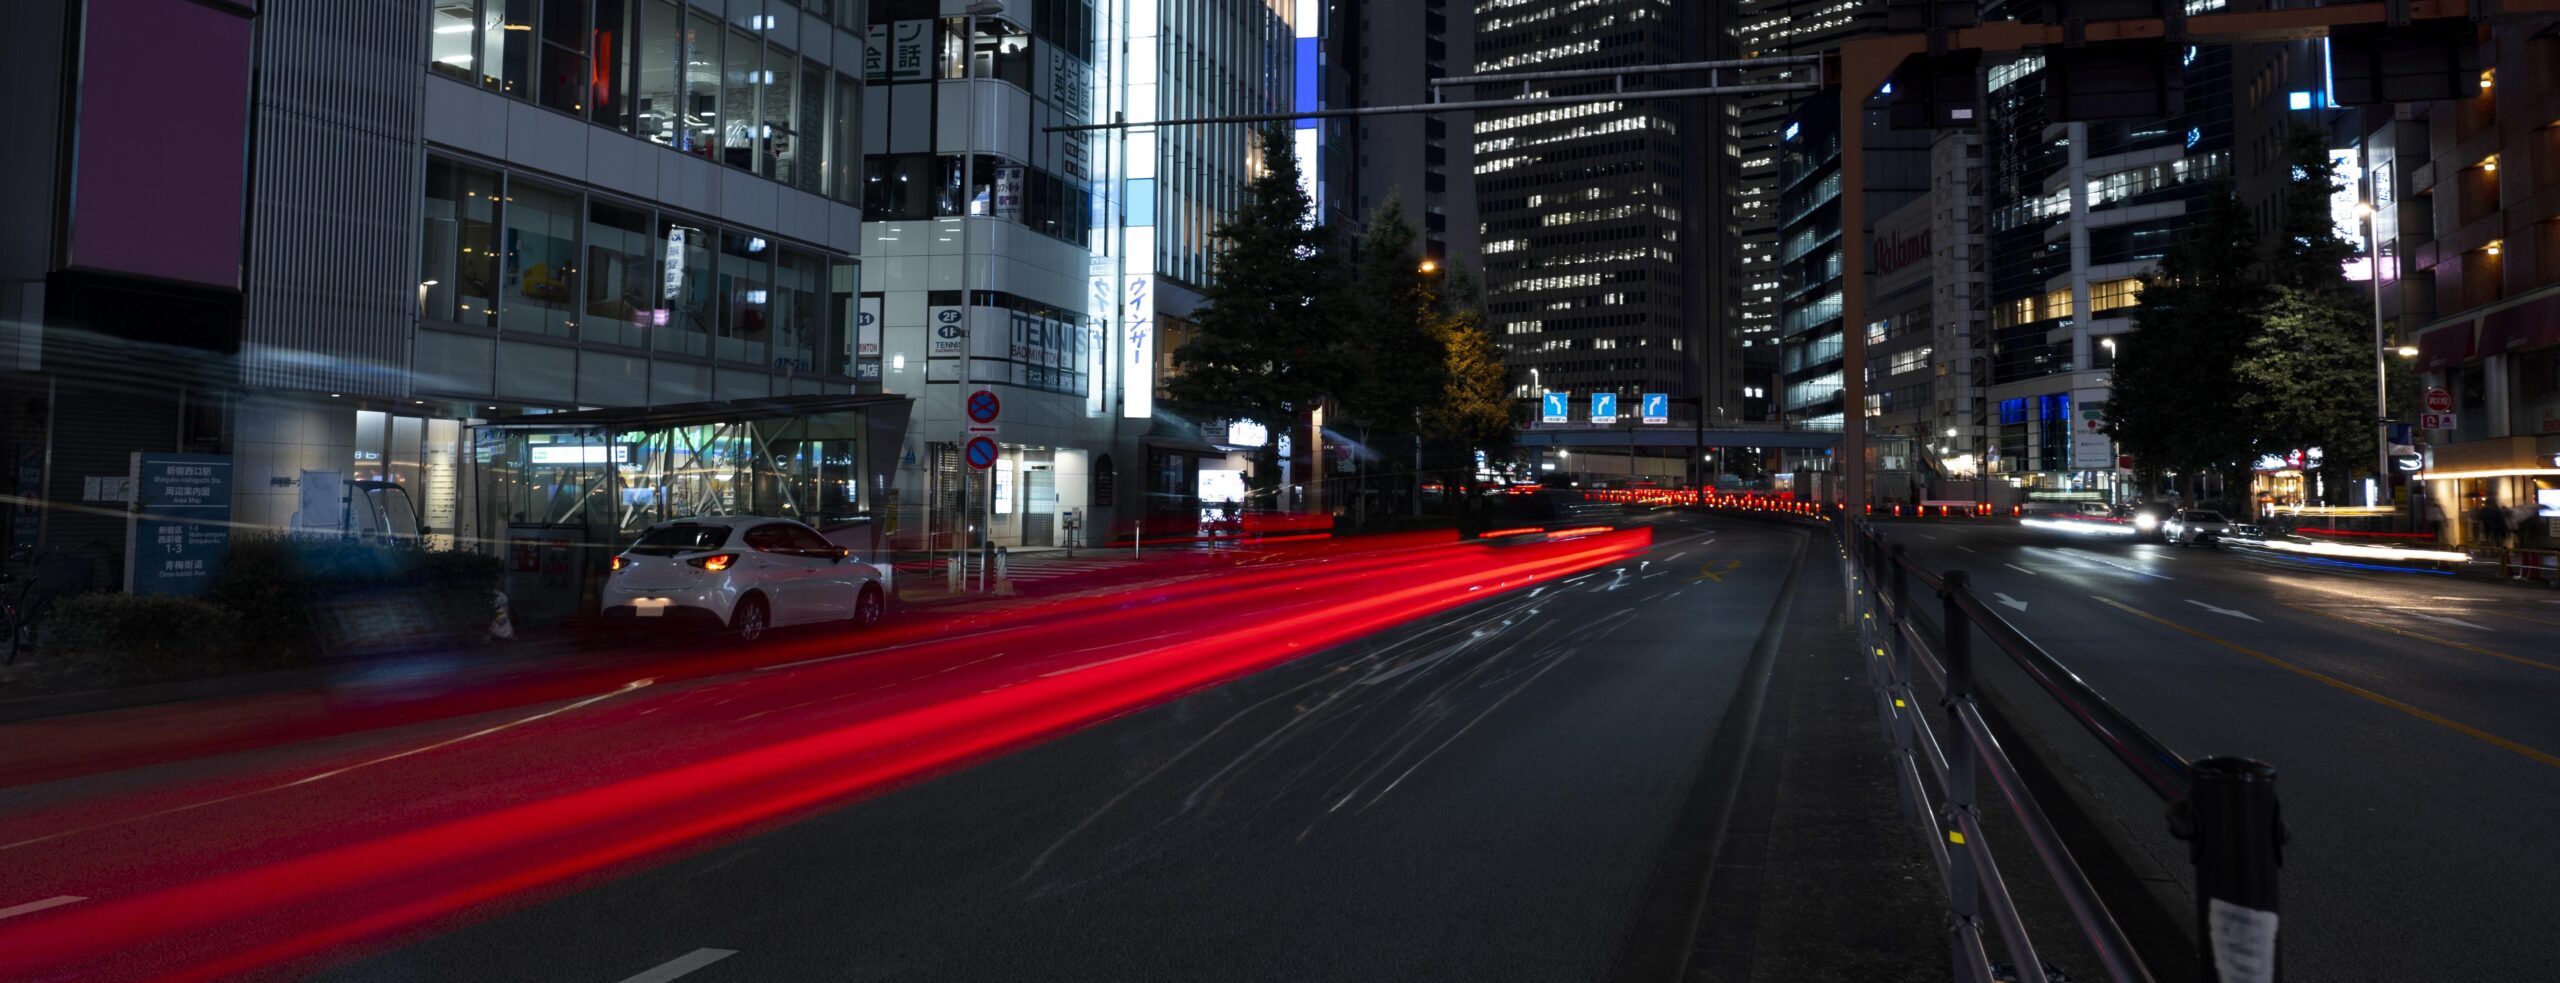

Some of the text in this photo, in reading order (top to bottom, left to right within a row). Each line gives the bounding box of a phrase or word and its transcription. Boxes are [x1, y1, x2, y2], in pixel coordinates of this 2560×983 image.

[942, 311, 958, 322] 2F
[1128, 277, 1151, 364] ウインザー
[1011, 313, 1087, 356] TENNIS
[166, 466, 212, 476] 新宿西口駅
[165, 486, 210, 496] 周辺案内図
[158, 526, 182, 535] 新宿区
[165, 544, 183, 554] 1-3
[166, 560, 203, 570] 青梅街道
